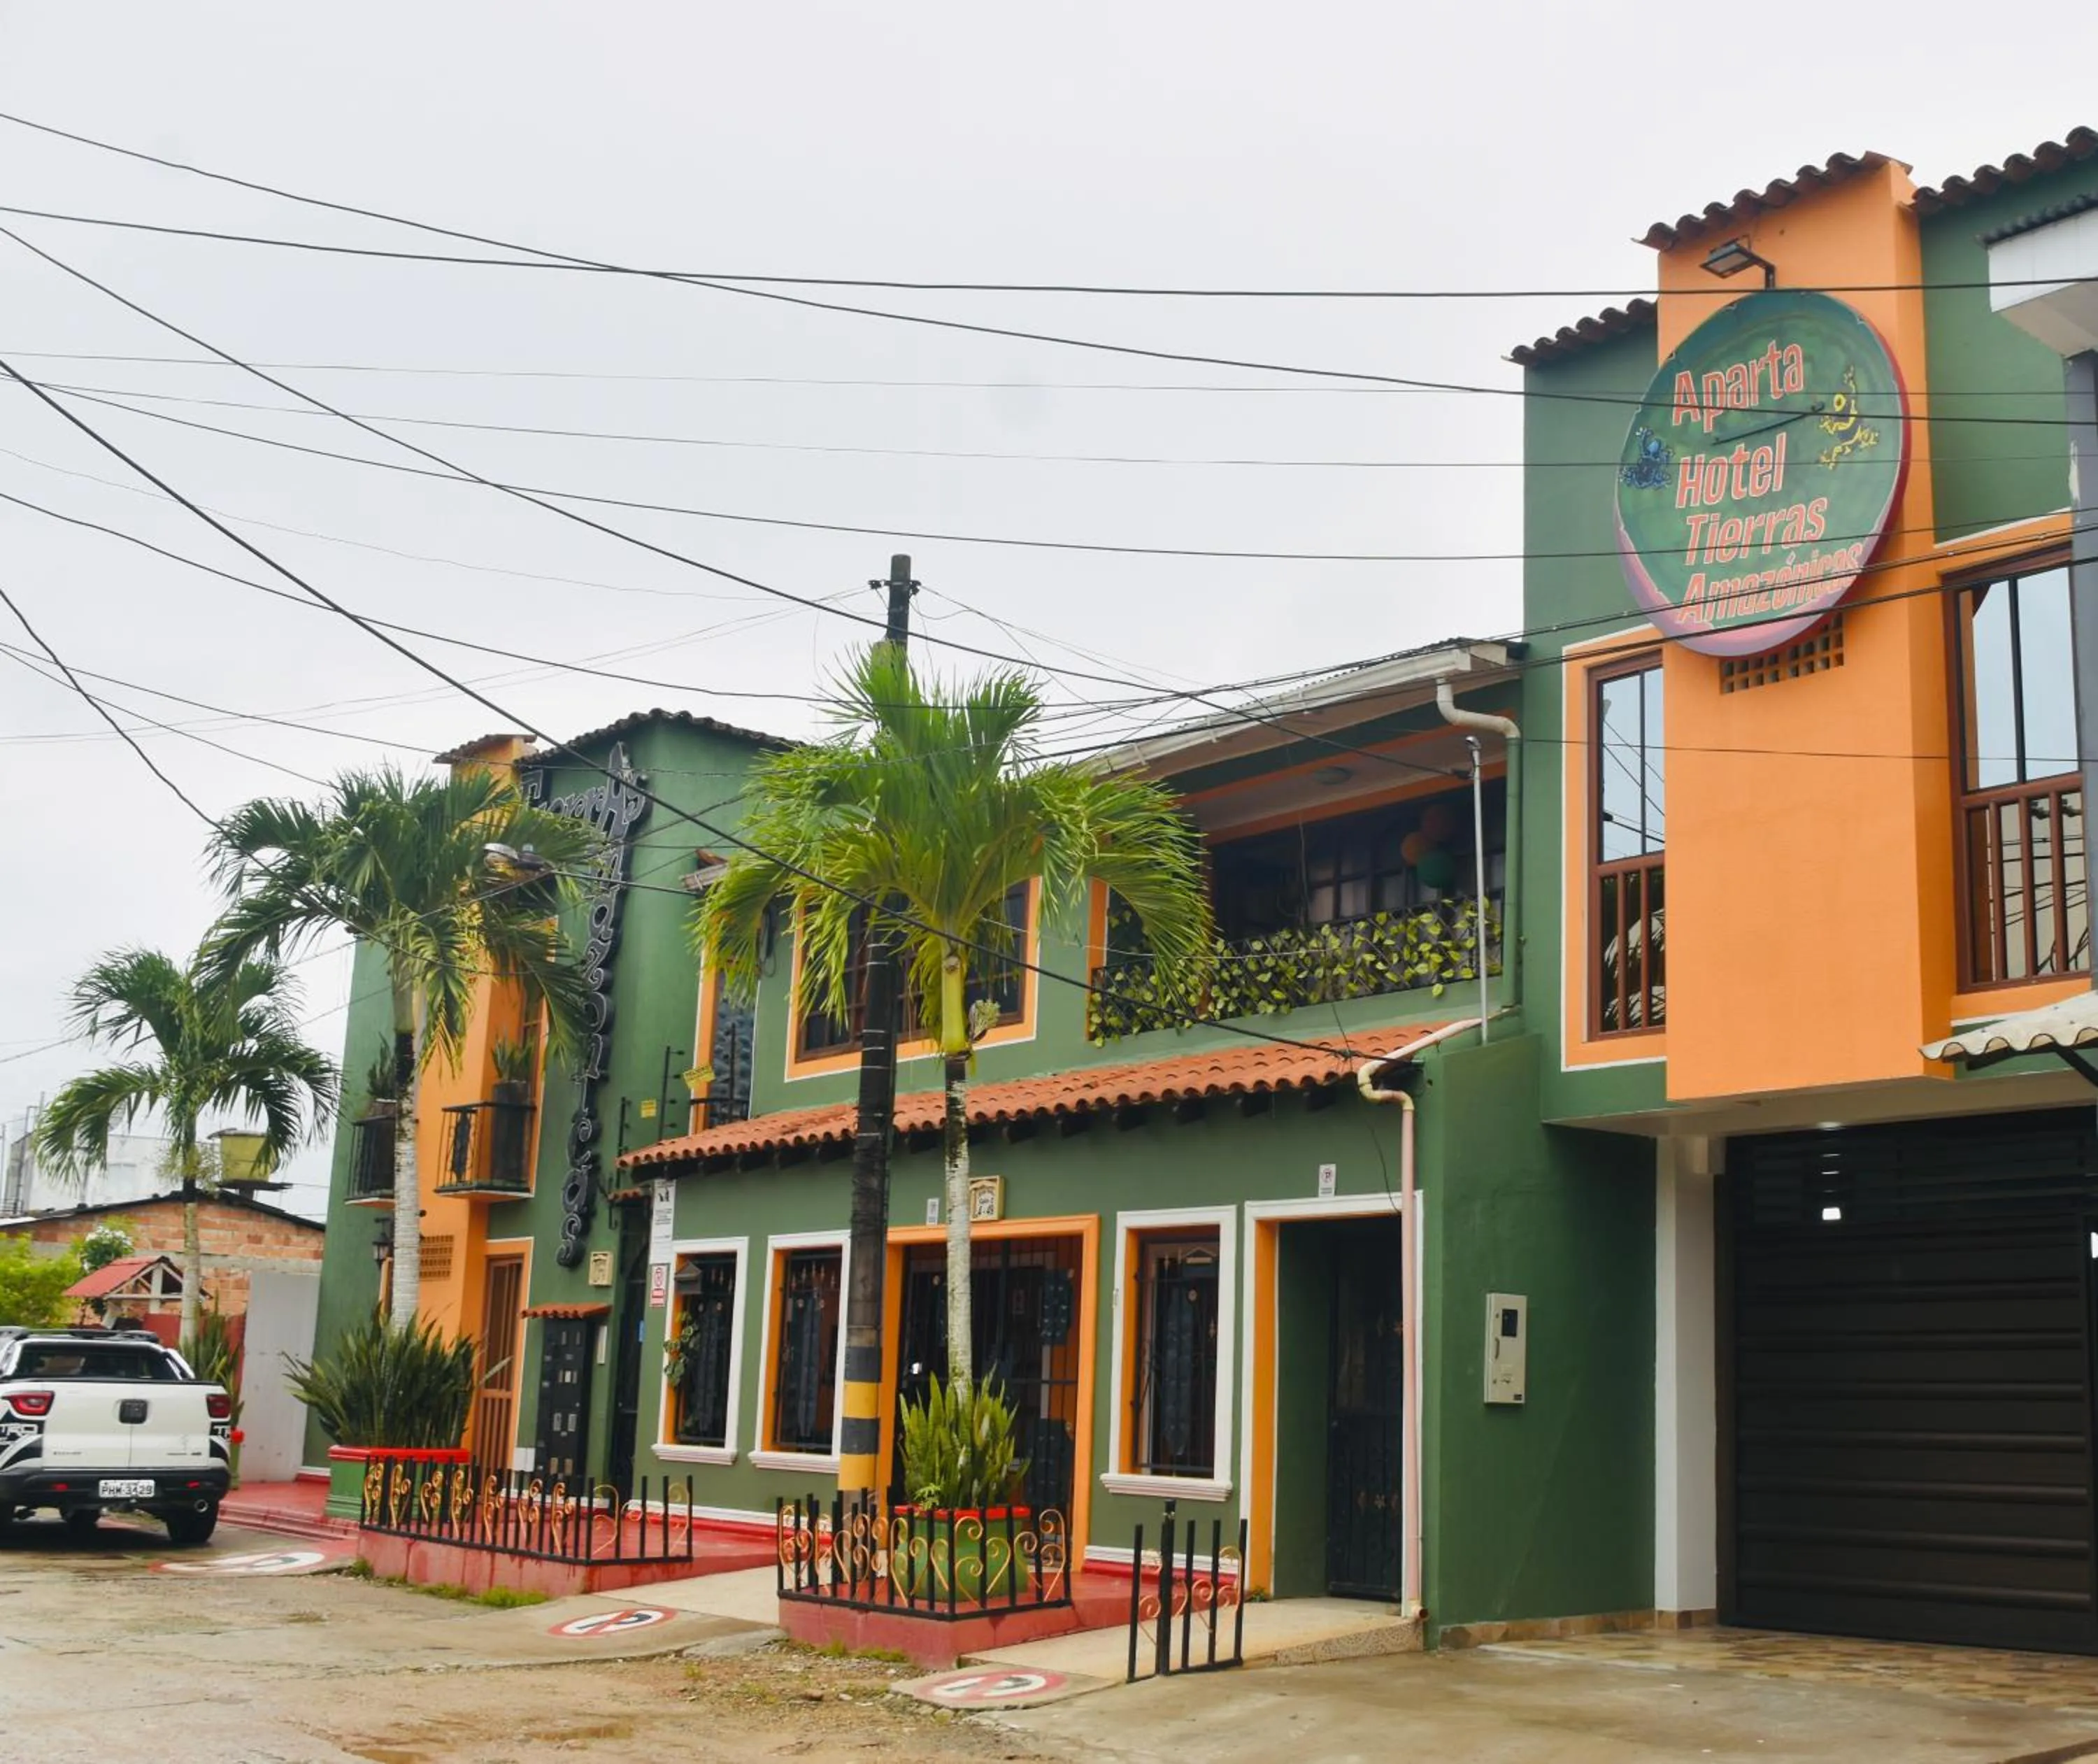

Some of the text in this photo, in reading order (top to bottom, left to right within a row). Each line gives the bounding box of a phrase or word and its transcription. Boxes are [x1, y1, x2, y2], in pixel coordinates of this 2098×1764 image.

[1672, 340, 1804, 433] Aparta
[1676, 432, 1786, 508] Hotel
[1685, 497, 1828, 566] Tierras
[1676, 543, 1863, 624] Amazónicas
